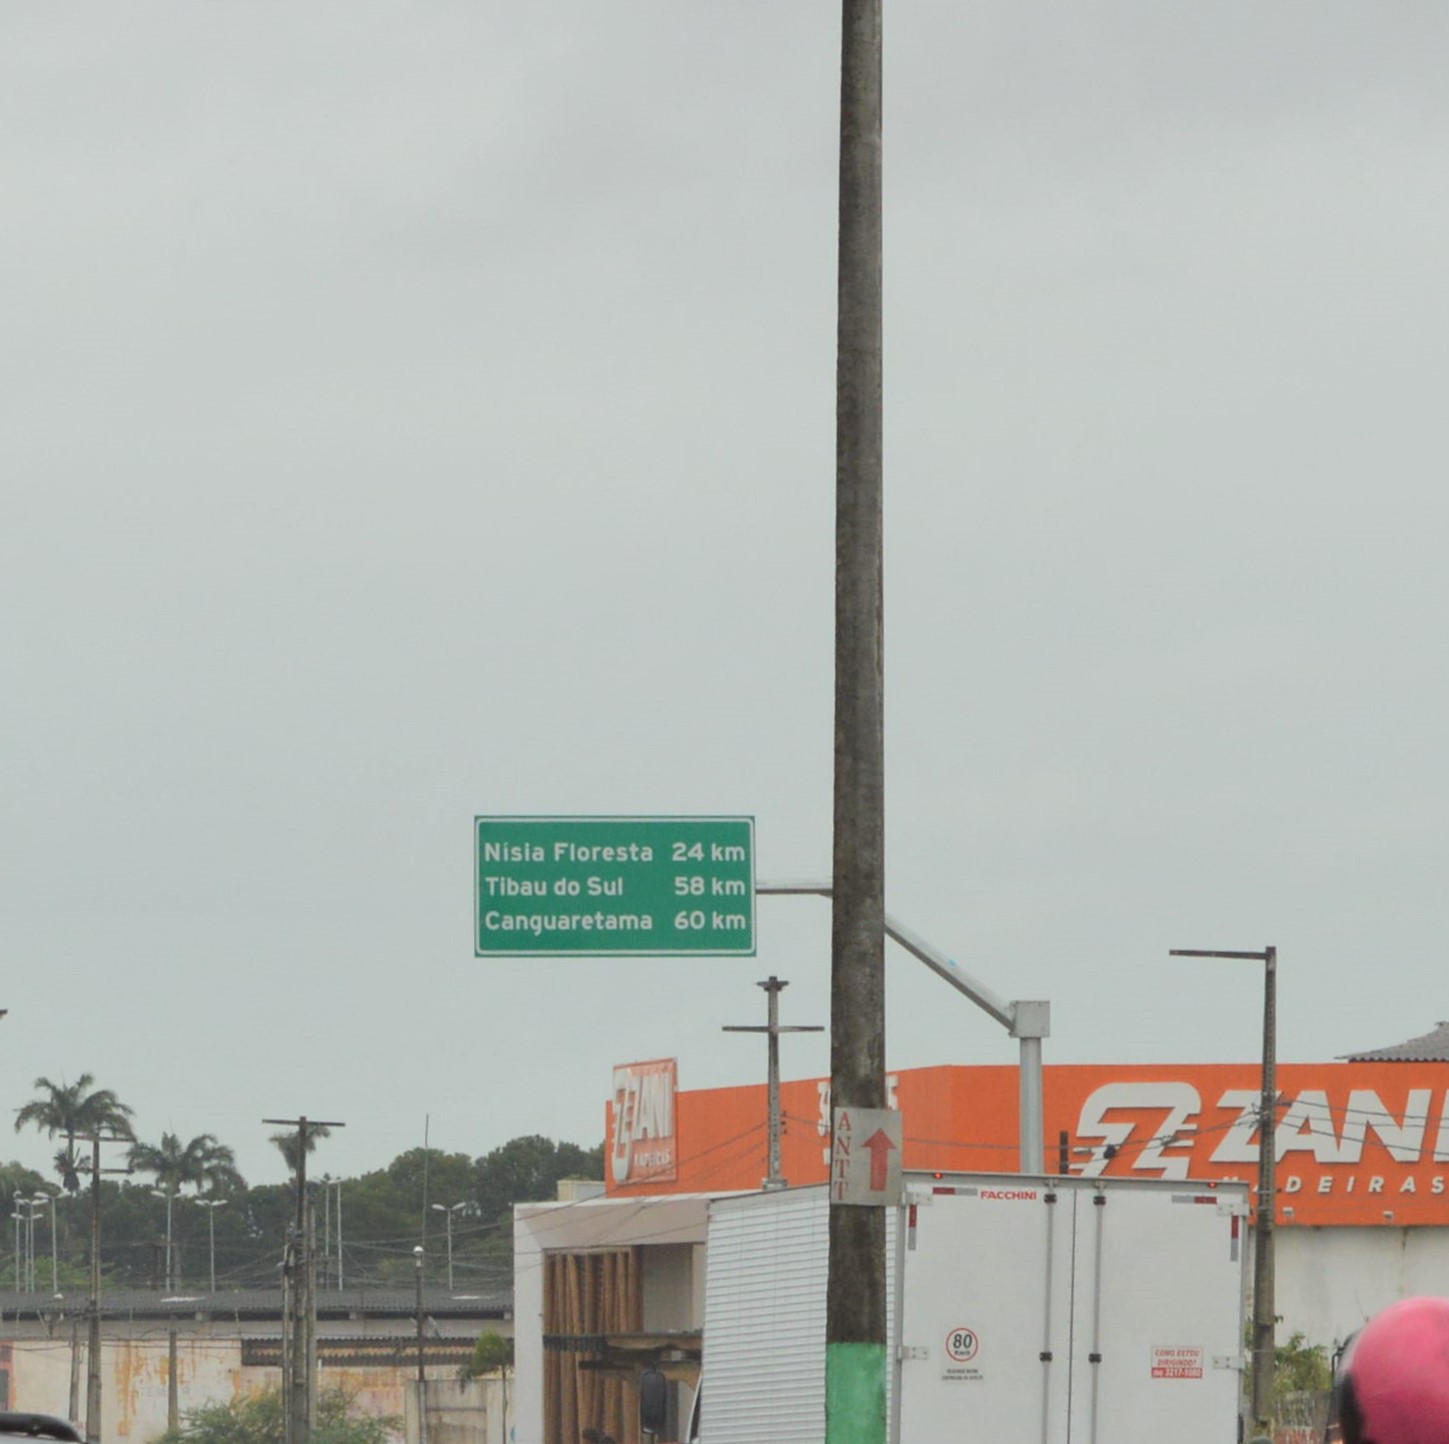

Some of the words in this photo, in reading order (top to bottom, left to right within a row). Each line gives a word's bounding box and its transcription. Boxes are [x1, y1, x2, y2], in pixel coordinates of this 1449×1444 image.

[554, 842, 653, 861] Floresta
[671, 842, 704, 861] 24
[711, 842, 745, 861] km
[485, 877, 547, 896] Tibau
[554, 877, 580, 896] do
[587, 877, 623, 896] Sul
[674, 877, 704, 896] 58
[712, 877, 745, 896] km
[485, 911, 653, 936] Canguaretama
[674, 911, 705, 930] 60
[712, 911, 746, 930] km
[834, 1110, 852, 1201] ANTT
[980, 1190, 1037, 1200] FACCHINI
[953, 1333, 973, 1349] 80
